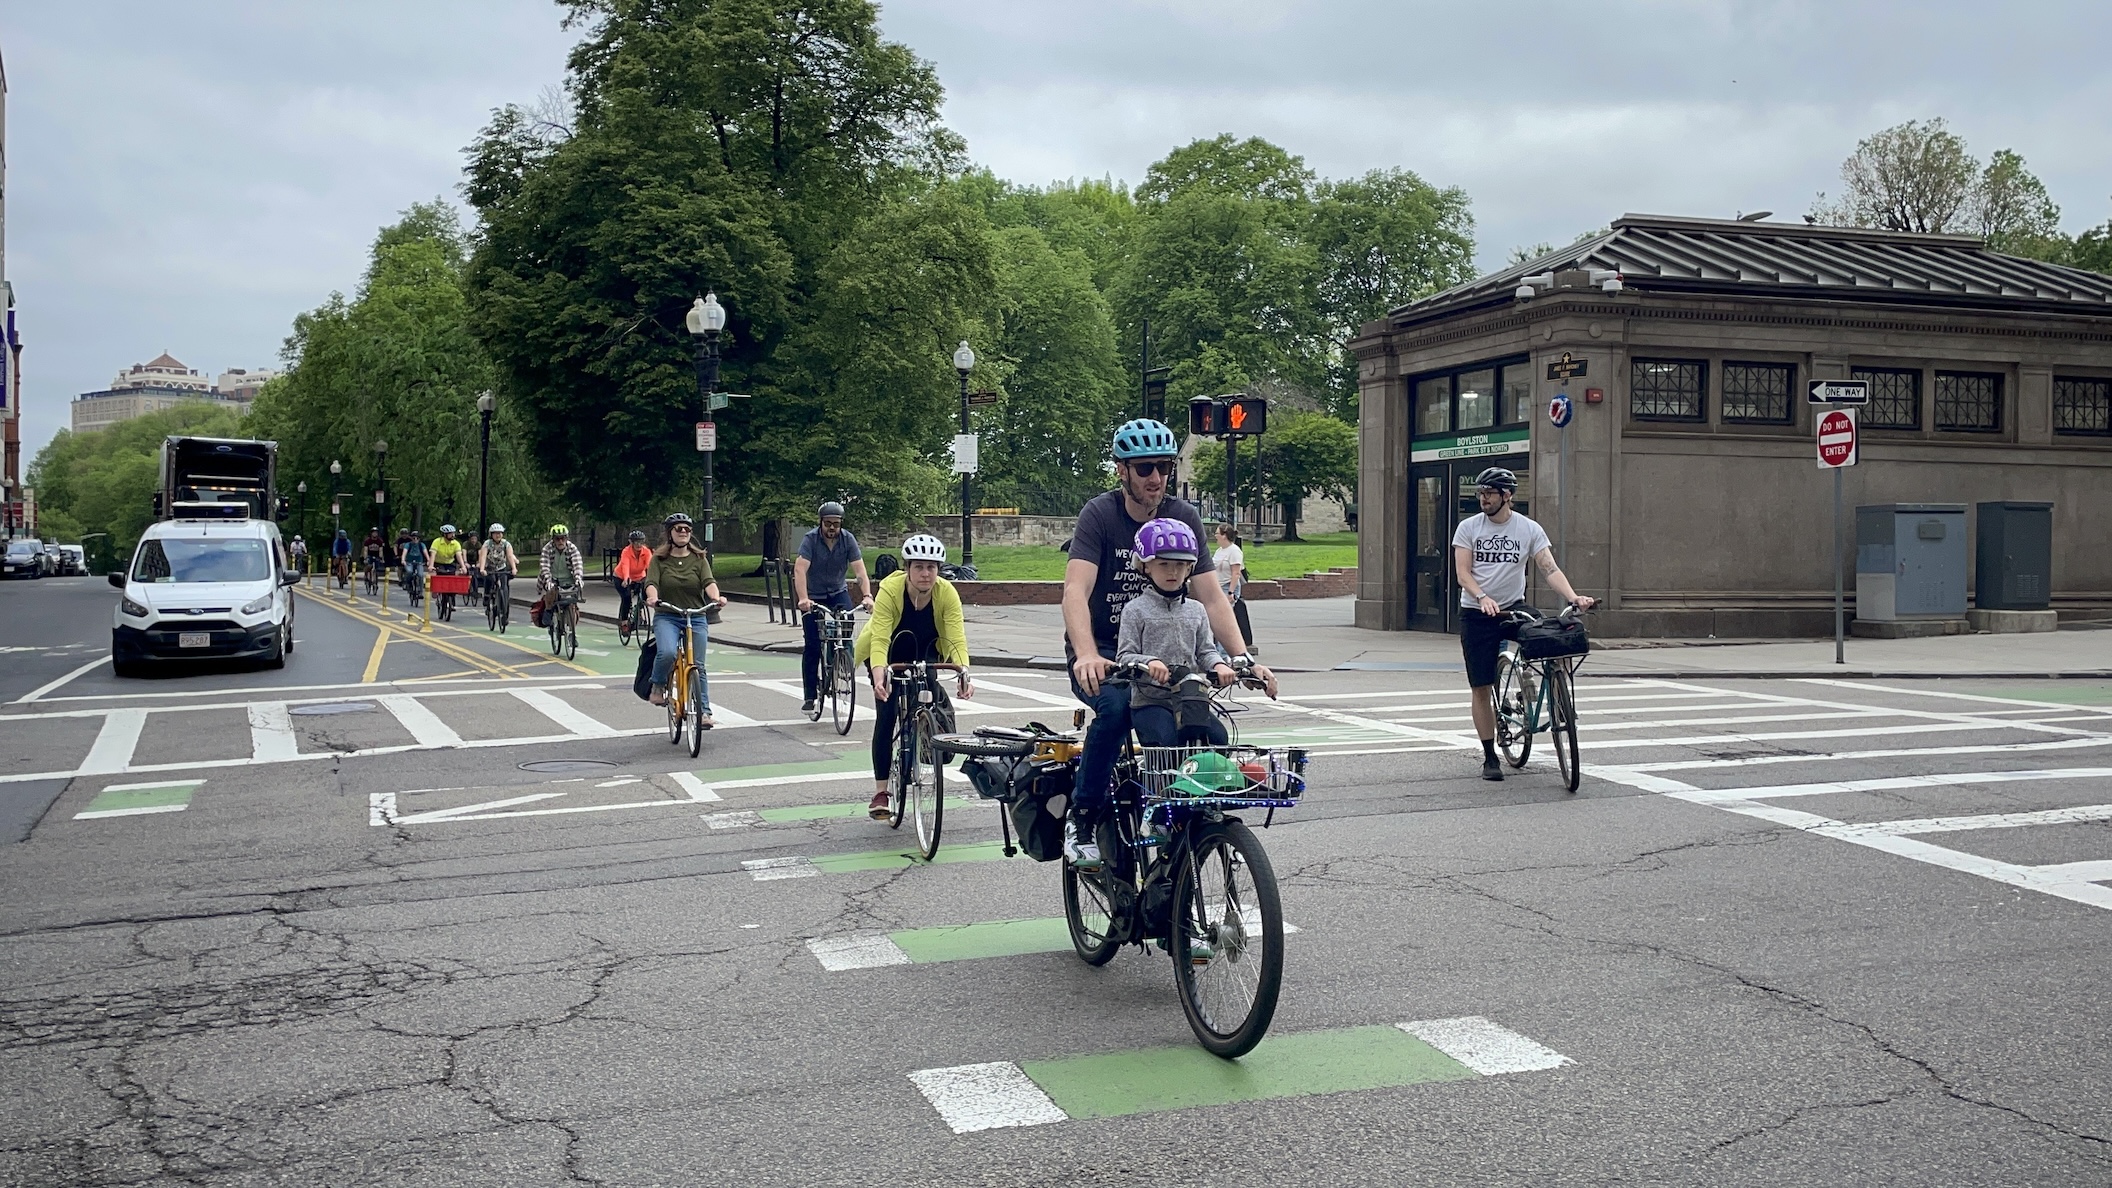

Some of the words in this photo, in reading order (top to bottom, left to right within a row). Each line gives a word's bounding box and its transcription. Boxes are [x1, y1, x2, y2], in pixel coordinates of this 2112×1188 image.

[1825, 387, 1841, 396] ONE
[1845, 387, 1861, 396] WAY
[1823, 422, 1832, 432] DO
[1836, 419, 1849, 429] NOT
[1457, 435, 1488, 446] BOYLSTON
[1440, 450, 1454, 458] GREEN
[1467, 447, 1480, 455] PARK
[1480, 446, 1487, 454] ST
[1491, 444, 1508, 453] NORTH
[1825, 445, 1846, 456] ENTER
[1476, 537, 1521, 551] BOSTON
[1475, 552, 1520, 563] BIKES
[1122, 583, 1140, 591] CAN
